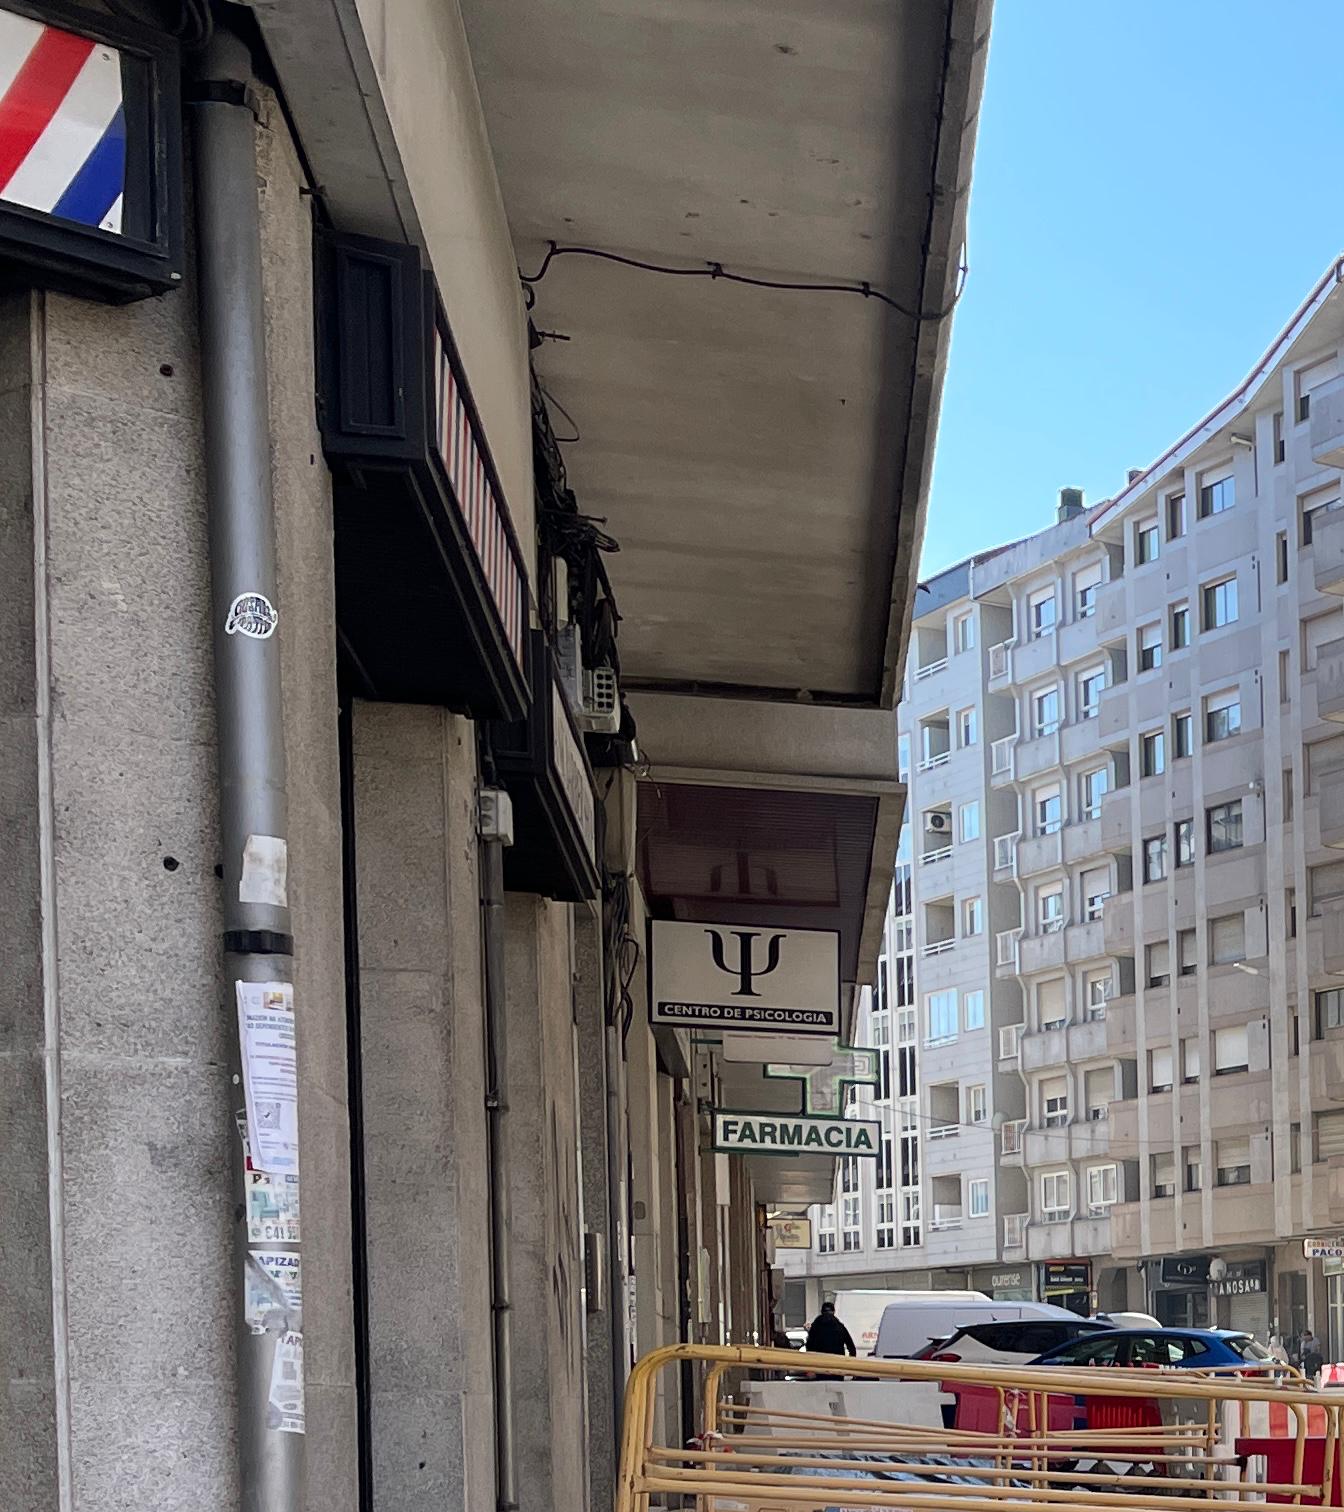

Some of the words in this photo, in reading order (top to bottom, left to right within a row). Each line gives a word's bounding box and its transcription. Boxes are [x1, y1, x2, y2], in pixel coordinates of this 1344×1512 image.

[664, 1004, 721, 1018] CENTRO
[723, 1007, 742, 1019] DE
[745, 1009, 827, 1024] PSICOLOGIA
[721, 1119, 875, 1151] FARMACIA
[1312, 1248, 1343, 1257] PACO
